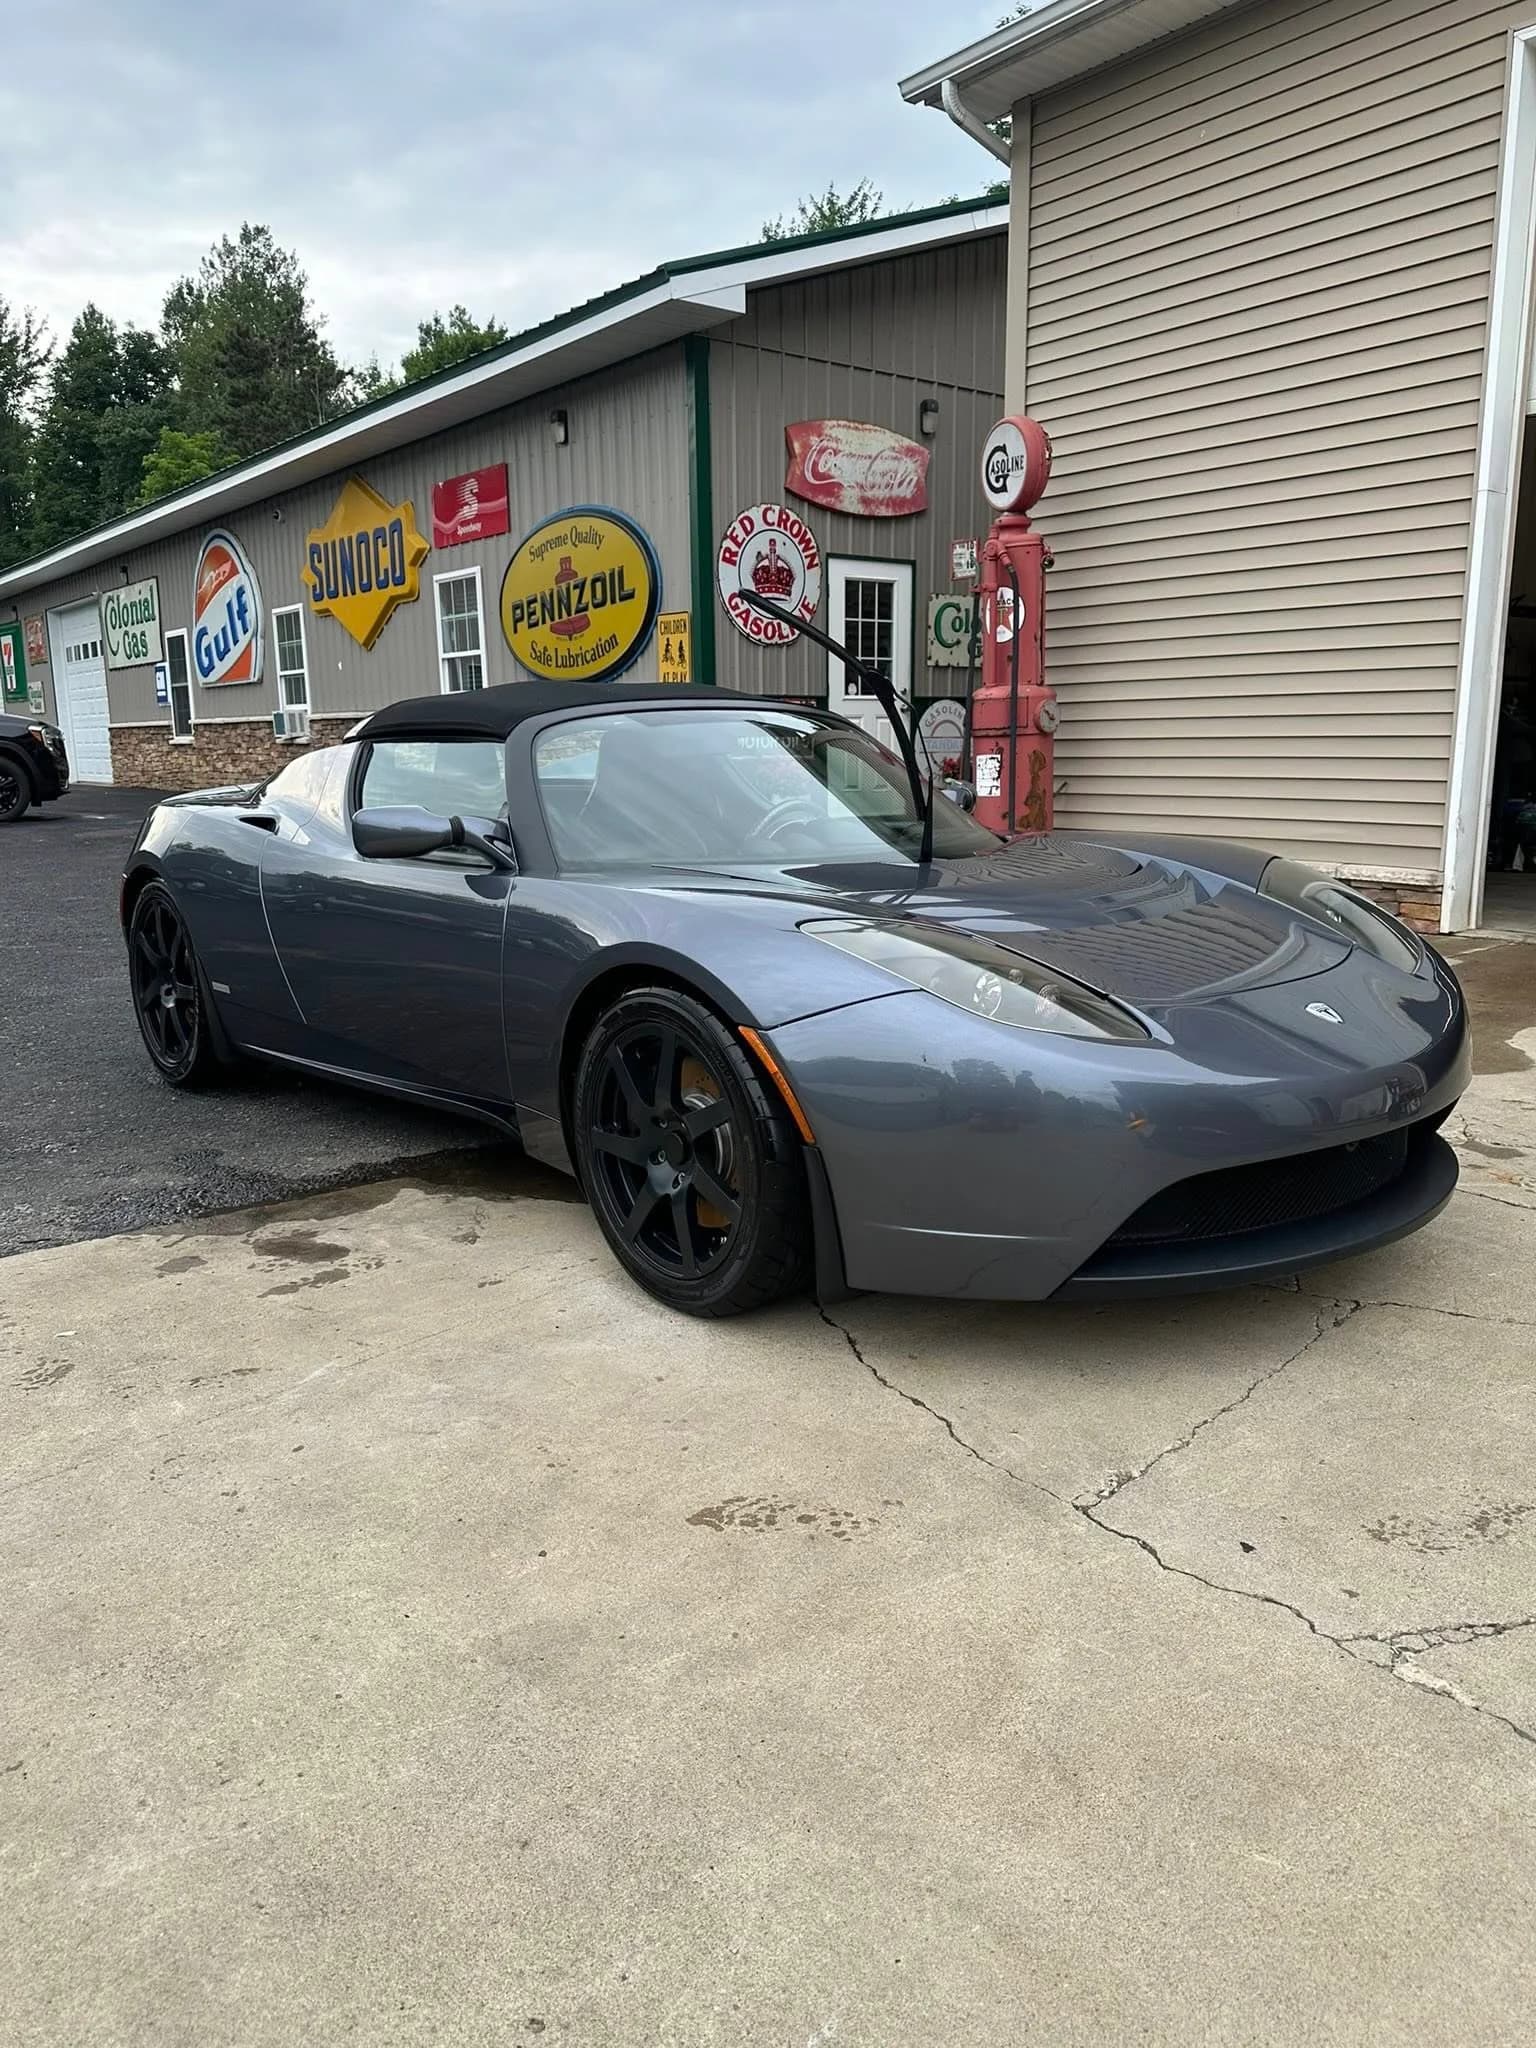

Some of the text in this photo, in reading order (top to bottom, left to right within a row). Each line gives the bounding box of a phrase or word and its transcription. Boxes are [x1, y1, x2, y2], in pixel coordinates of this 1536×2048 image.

[986, 443, 1025, 494] GASOLINE
[309, 518, 406, 602] SUNOCO
[529, 525, 605, 562] Supreme Quality
[721, 506, 819, 570] RED CROWN
[104, 584, 157, 656] Colonial
[511, 565, 636, 635] PENNZOIL
[728, 592, 816, 641] GASOLE
[122, 629, 149, 660] Gas
[195, 584, 249, 679] Gulf
[660, 618, 687, 636] CHILDREN
[935, 602, 972, 648] Col
[530, 633, 619, 669] Safe Lubrication
[925, 705, 963, 728] GASOLIN
